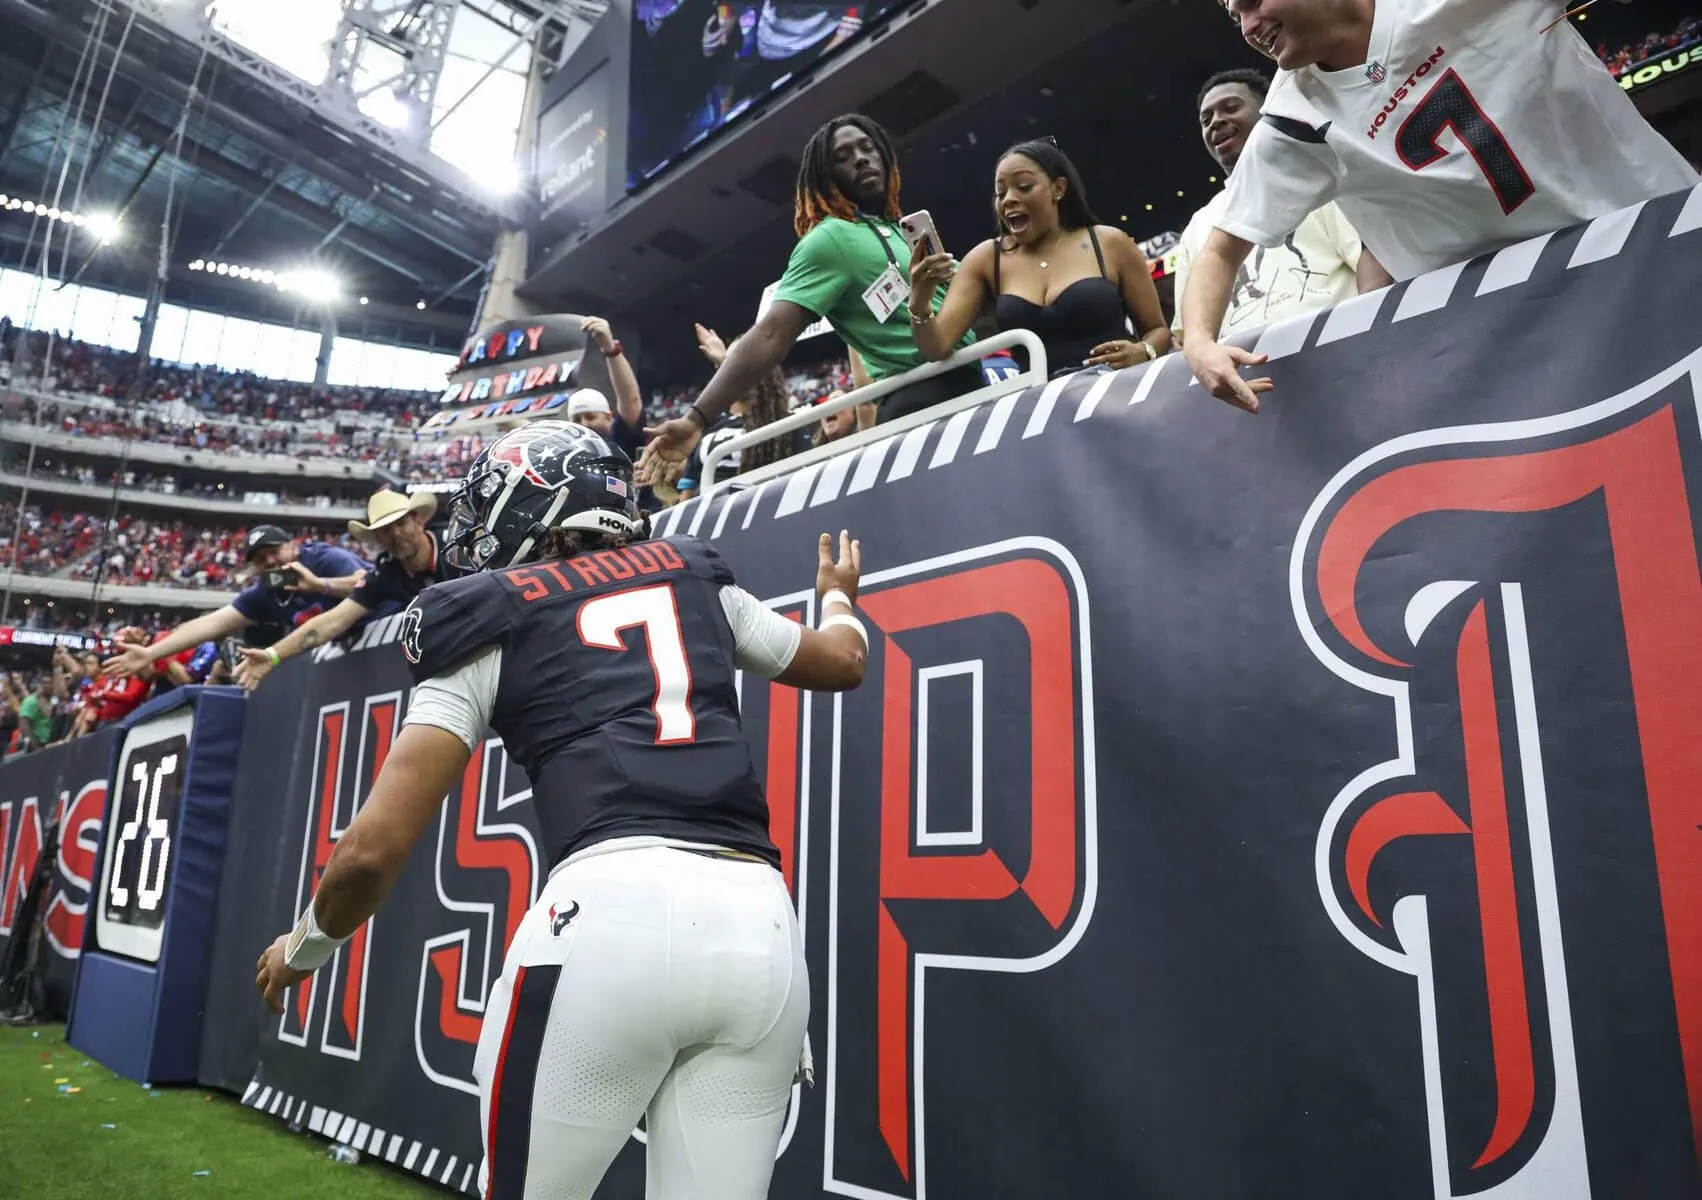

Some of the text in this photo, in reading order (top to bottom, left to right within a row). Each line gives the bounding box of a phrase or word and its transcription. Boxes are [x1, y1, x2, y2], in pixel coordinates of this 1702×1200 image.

[1367, 46, 1445, 140] HOUSTON
[1395, 66, 1536, 216] 7
[439, 360, 579, 402] BIRTHDAY
[504, 541, 686, 601] STROUD
[575, 581, 696, 744] 7
[0, 779, 108, 959] NS
[111, 755, 177, 910] 26
